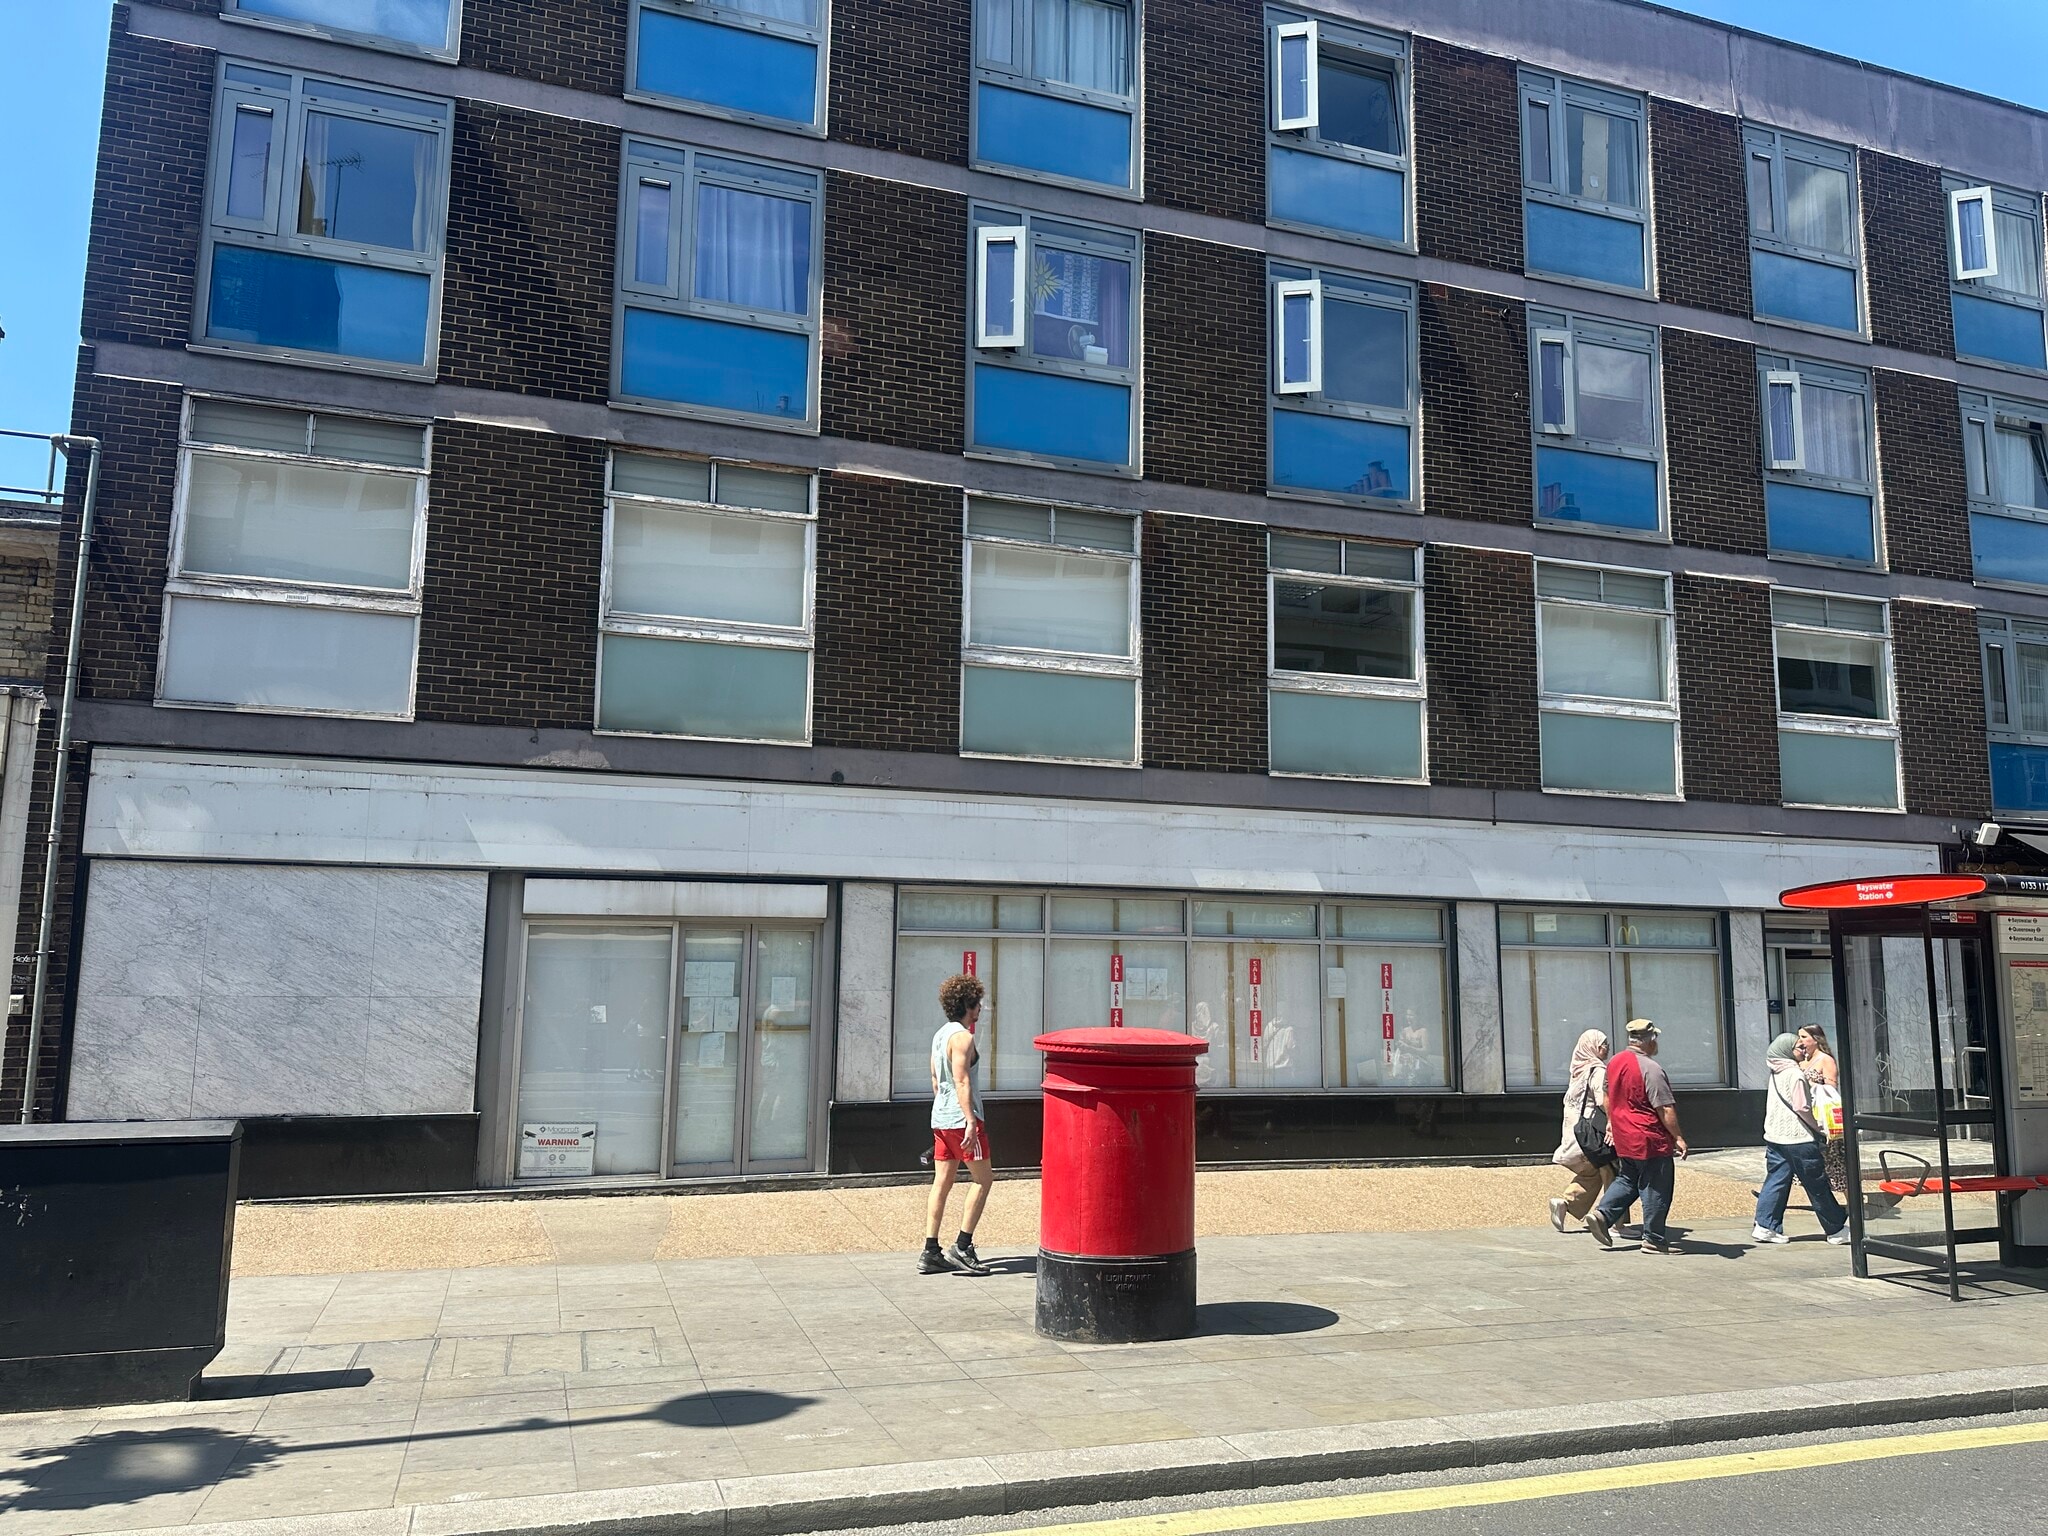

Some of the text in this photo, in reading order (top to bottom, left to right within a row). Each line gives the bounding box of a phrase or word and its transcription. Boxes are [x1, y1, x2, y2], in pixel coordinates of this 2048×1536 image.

[1856, 882, 1894, 892] Bayswater
[2020, 881, 2037, 890] 0133
[1858, 892, 1885, 900] Station
[537, 1138, 580, 1146] WARNING
